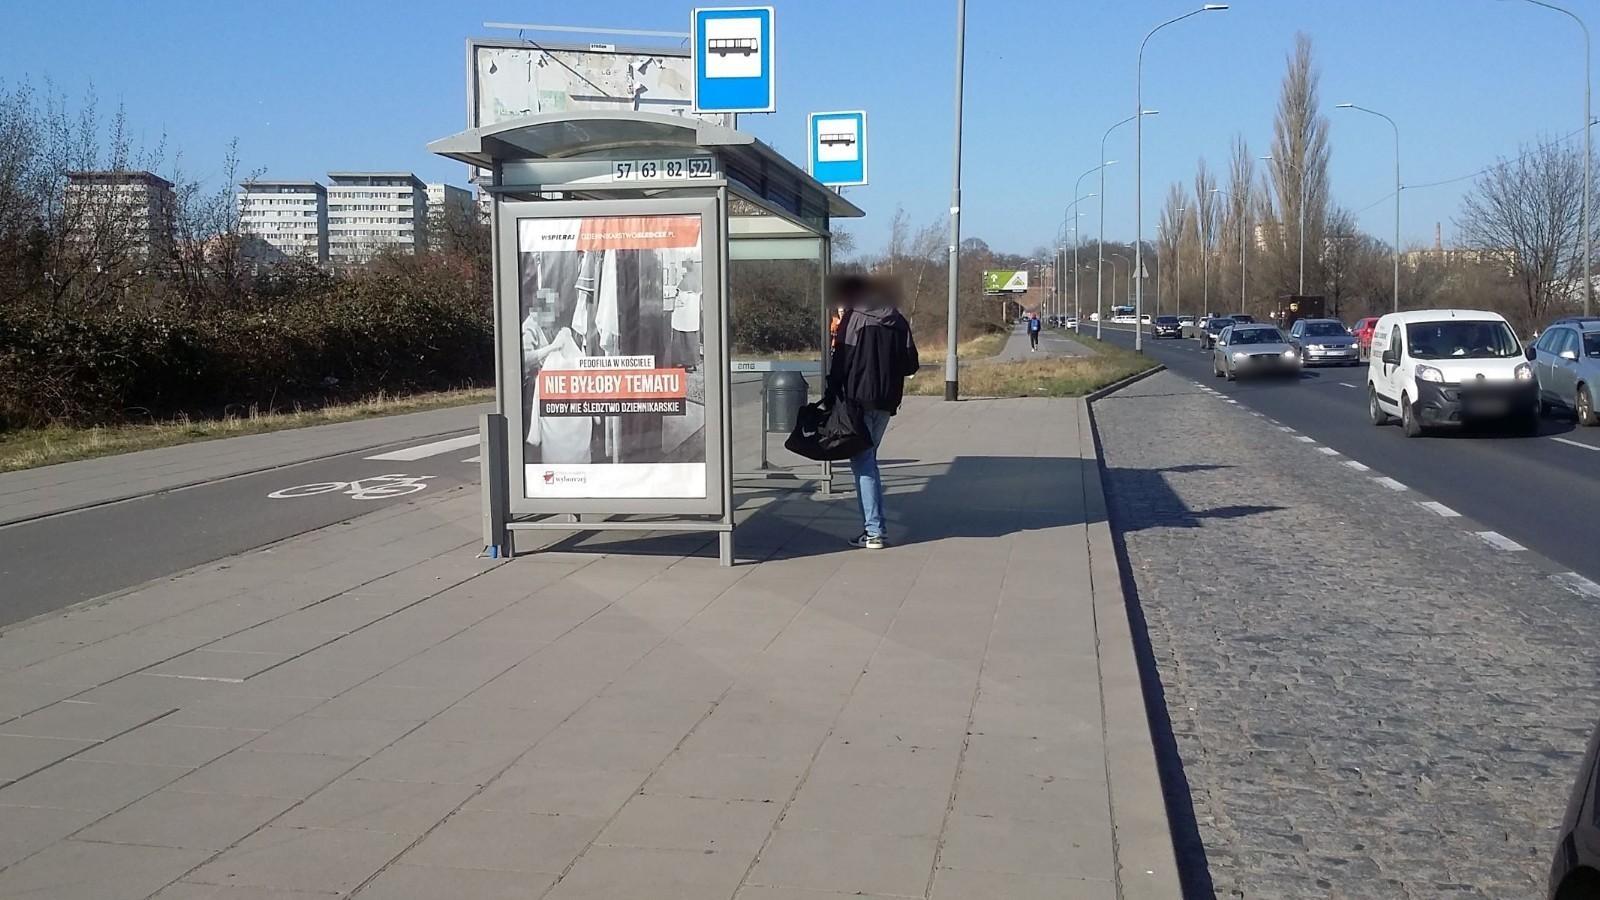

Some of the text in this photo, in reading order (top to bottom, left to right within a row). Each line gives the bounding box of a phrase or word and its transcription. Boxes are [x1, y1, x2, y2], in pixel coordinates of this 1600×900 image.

[617, 160, 711, 178] 57 63 82 522
[541, 233, 576, 241] WSPIERAJ
[579, 358, 652, 368] PEDOFILIA W KOŚCIELE
[545, 374, 679, 394] NIE BYŁOBY TEMATU
[546, 401, 680, 413] GDYBY NIE ŚLEDZTWO DZIENNIKARSKIE
